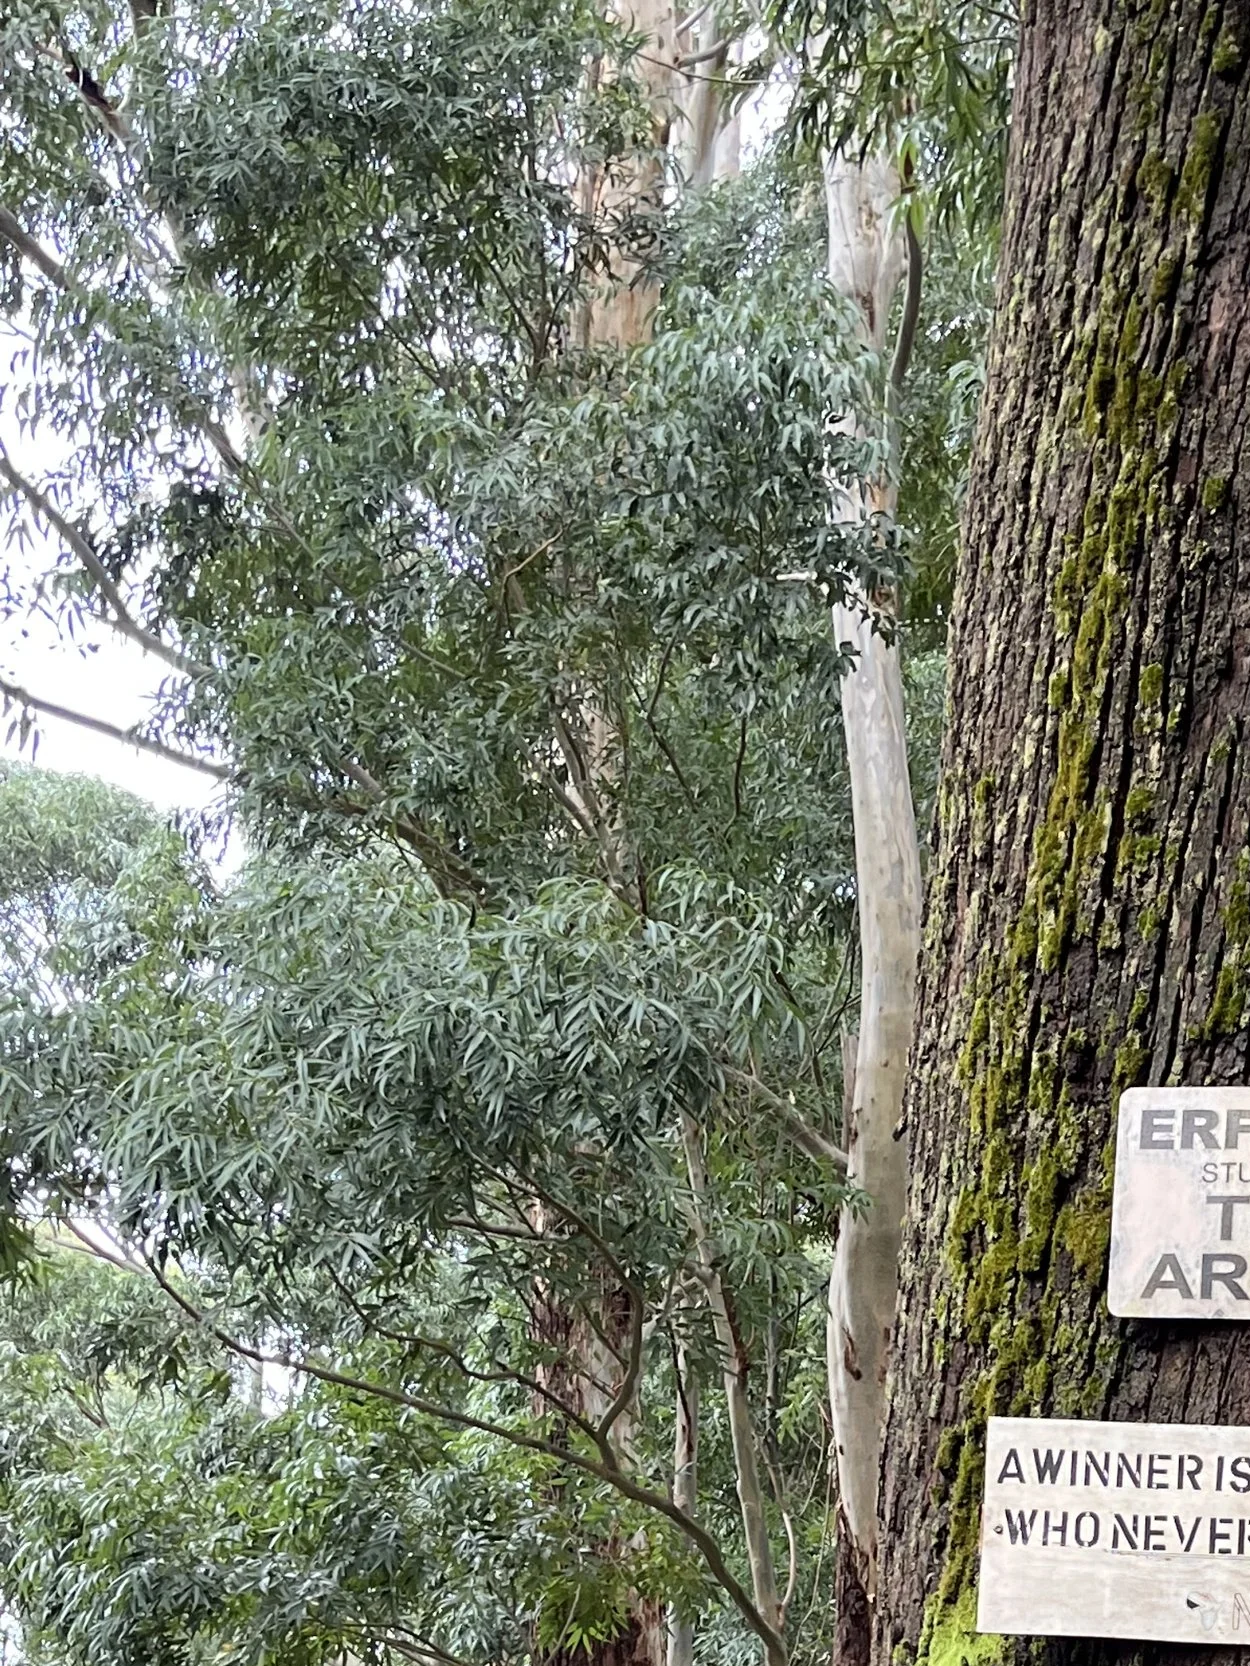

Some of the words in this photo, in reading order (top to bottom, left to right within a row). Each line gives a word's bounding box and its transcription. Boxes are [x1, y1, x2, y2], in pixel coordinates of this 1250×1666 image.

[997, 1448, 1026, 1485] A
[1032, 1448, 1203, 1491] WINNER
[1004, 1508, 1100, 1548] WHO
